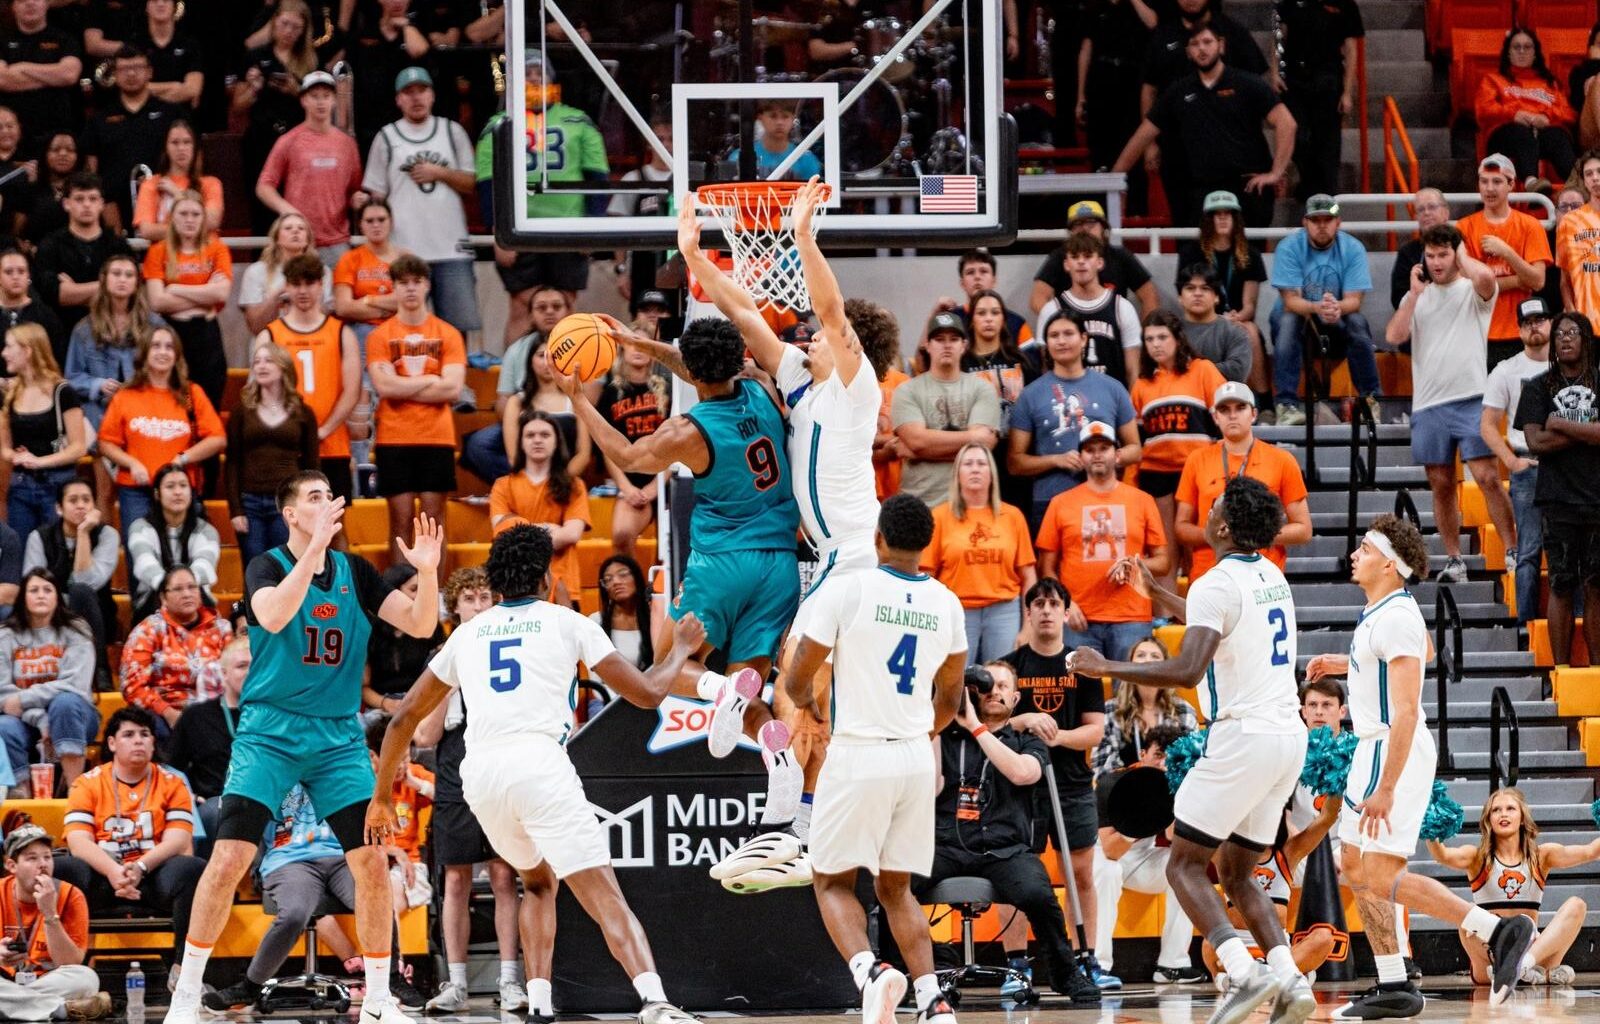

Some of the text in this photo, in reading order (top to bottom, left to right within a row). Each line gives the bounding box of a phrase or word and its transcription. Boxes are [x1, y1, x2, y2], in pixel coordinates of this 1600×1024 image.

[296, 350, 315, 392] 1
[611, 393, 658, 420] OKLAHO
[736, 415, 760, 440] ROY
[746, 437, 780, 491] 9
[477, 620, 541, 638] ISLANDERS
[875, 604, 938, 632] ISLANDERS
[1268, 611, 1289, 666] 2
[302, 625, 344, 667] 19
[490, 637, 522, 692] 5
[886, 633, 918, 696] 4
[1017, 676, 1056, 688] OKLAHOMA
